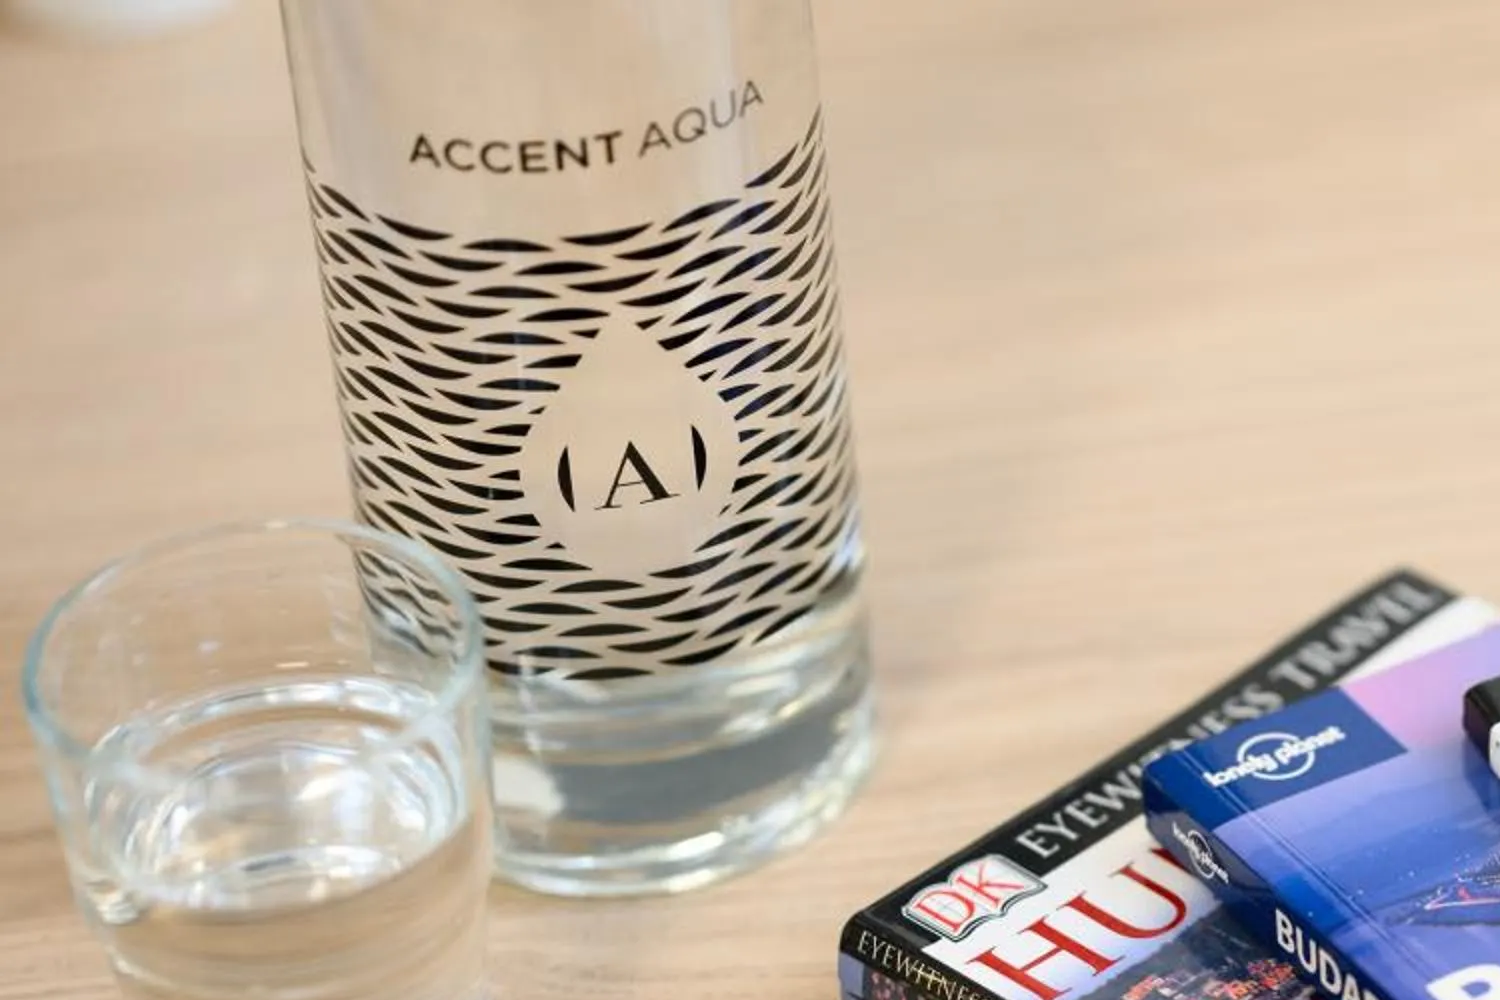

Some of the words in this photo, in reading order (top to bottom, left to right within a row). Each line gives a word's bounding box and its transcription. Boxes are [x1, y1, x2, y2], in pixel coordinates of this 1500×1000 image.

[409, 131, 623, 174] ACCENT
[637, 79, 764, 159] AQUA
[1202, 752, 1279, 787] lonely
[1274, 725, 1347, 765] planet
[912, 861, 1026, 933] DK
